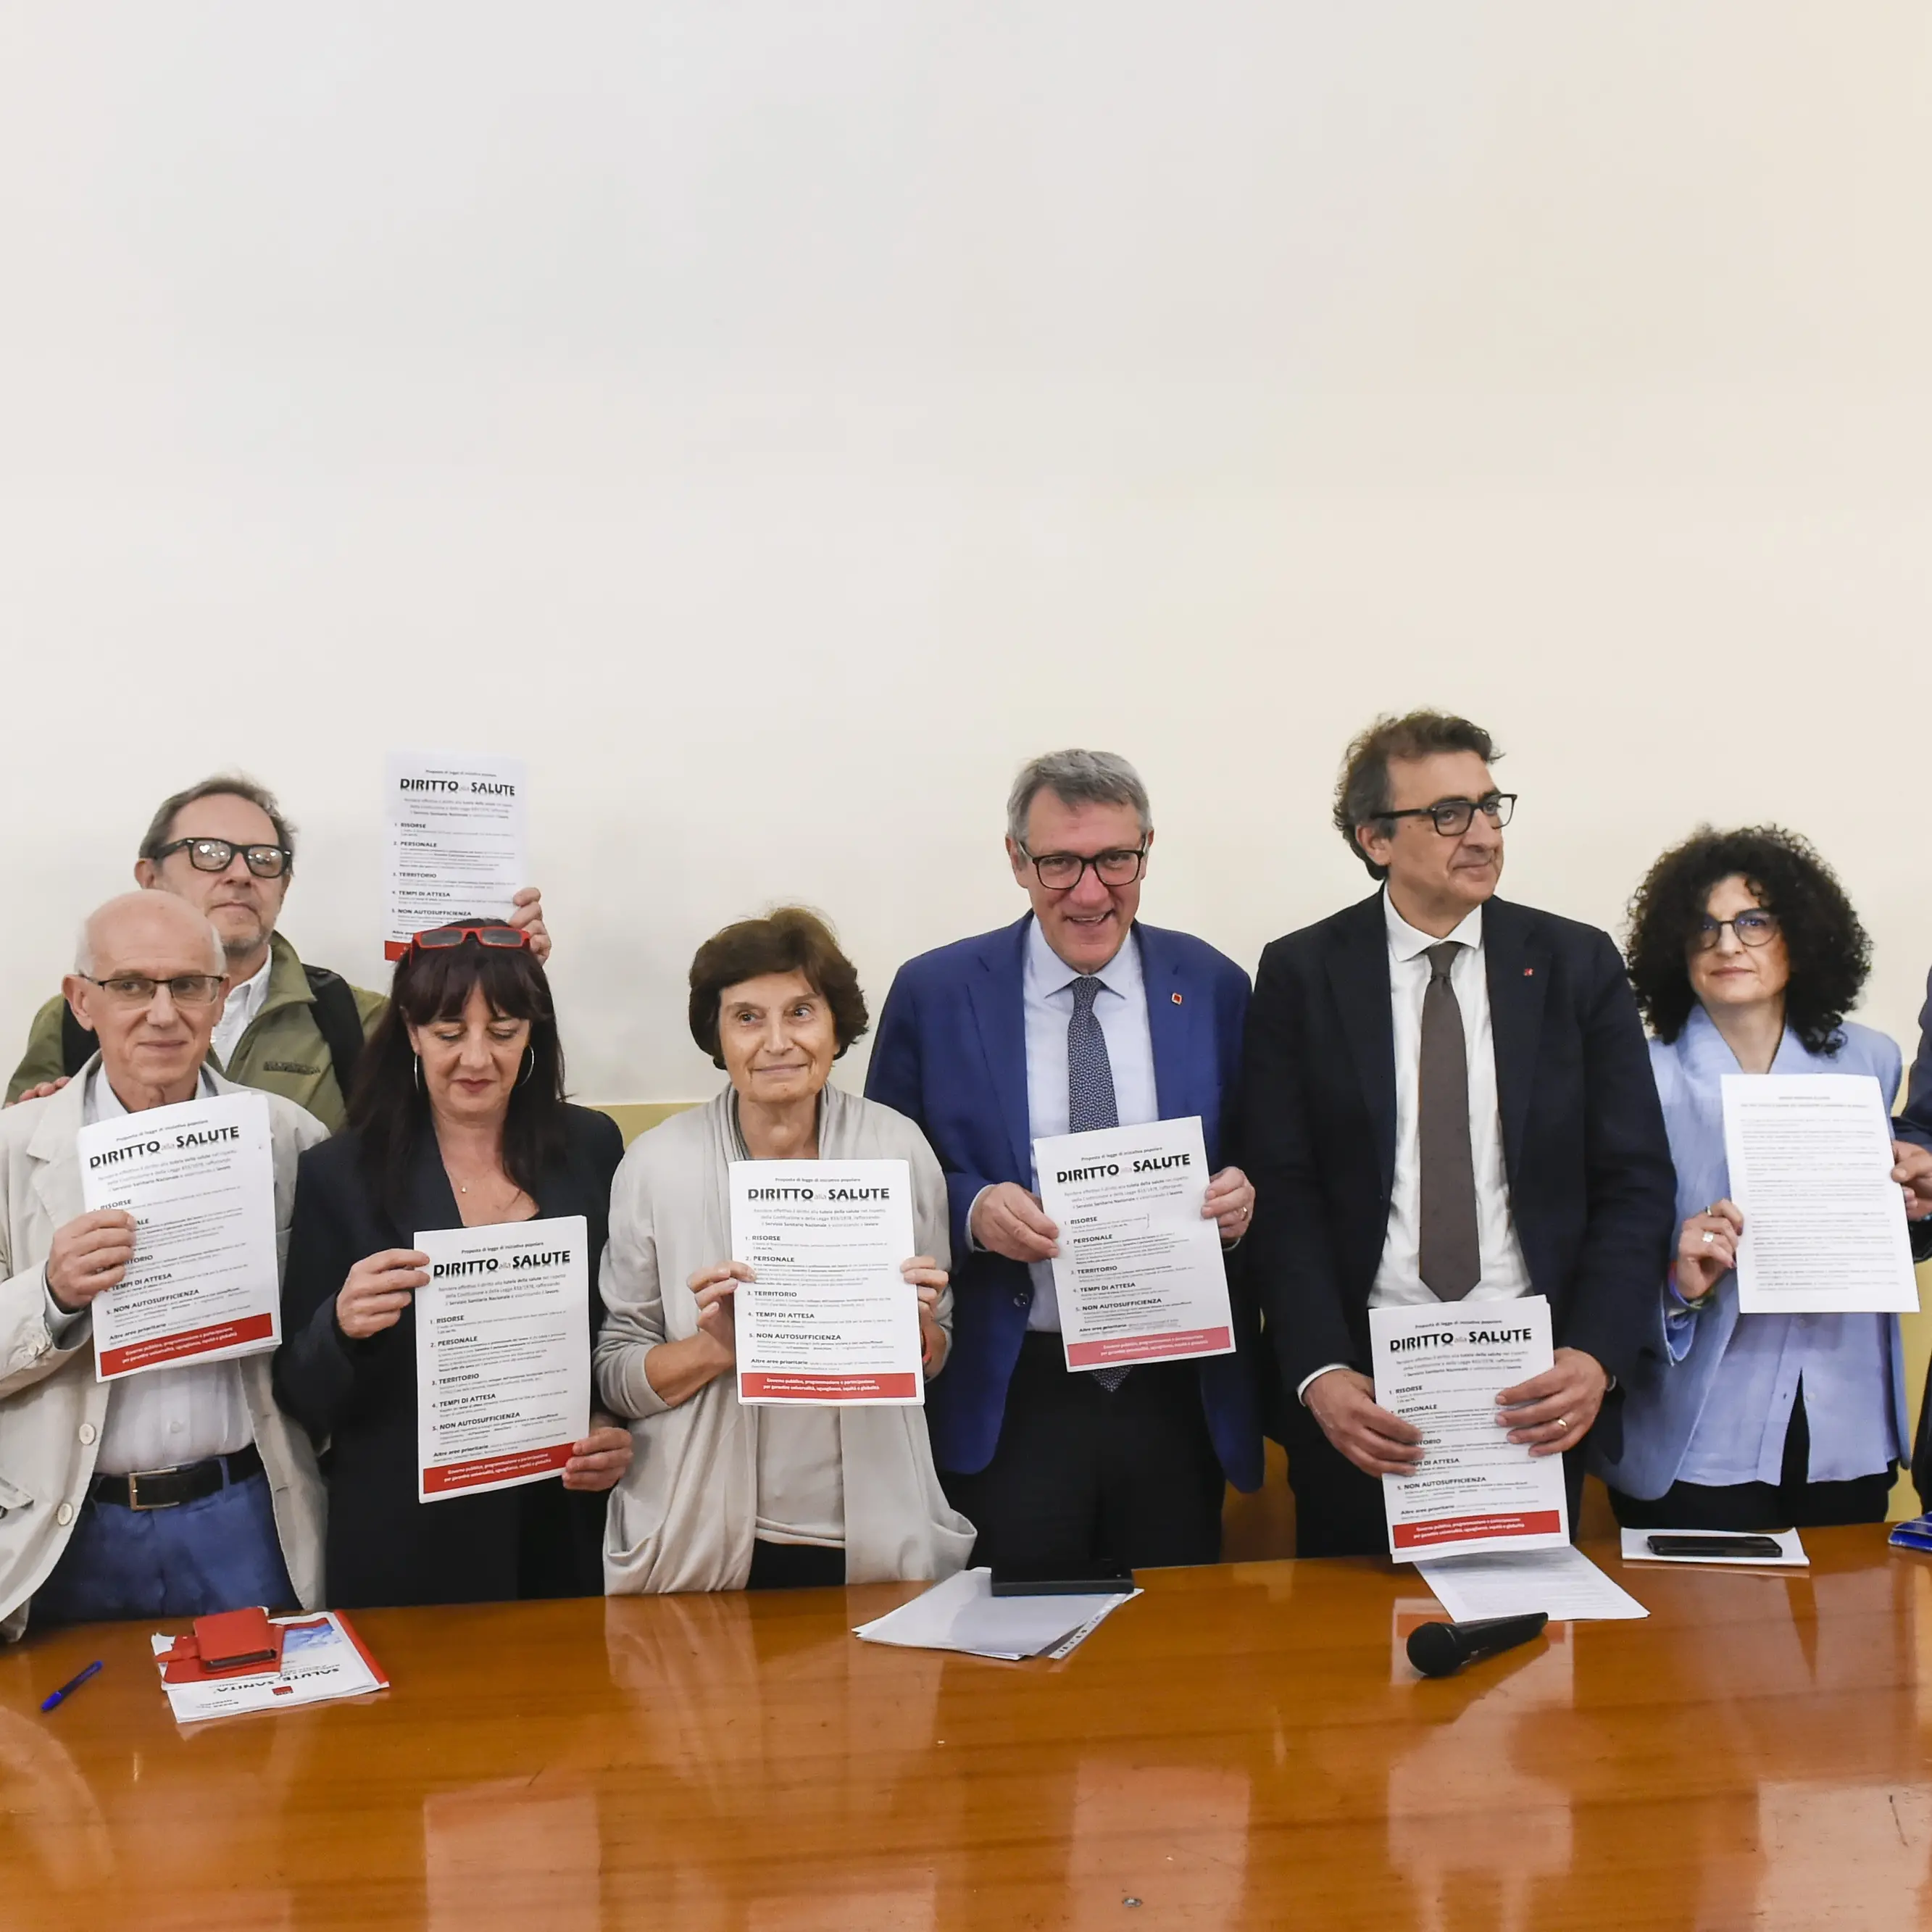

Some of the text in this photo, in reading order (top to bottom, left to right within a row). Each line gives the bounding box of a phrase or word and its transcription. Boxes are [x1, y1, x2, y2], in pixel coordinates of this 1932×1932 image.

[400, 778, 515, 796] DIRITTO SALUTE
[90, 1141, 161, 1169] DIRITTO
[176, 1126, 240, 1148] SALUTE
[1057, 1164, 1120, 1183] DIRITTO
[1133, 1154, 1191, 1172] SALUTE
[748, 1188, 814, 1199] DIRITTO
[828, 1188, 890, 1199] SALUTE
[100, 1199, 131, 1209] RISORSE
[1073, 1234, 1113, 1244] PERSONALE
[433, 1258, 499, 1277] DIRITTO
[512, 1250, 570, 1267] SALUTE
[1078, 1265, 1117, 1274] TERRITORIO
[112, 1281, 133, 1291] TEMPI
[143, 1273, 172, 1283] ATTESA
[114, 1304, 130, 1313] NON
[132, 1288, 199, 1308] AUTOSUFFICIENZA
[1099, 1298, 1162, 1309] AUTOSUFFICIENZA
[438, 1336, 478, 1346] PERSONALE
[1390, 1333, 1454, 1352] DIRITTO
[1469, 1328, 1532, 1343] SALUTE
[438, 1373, 479, 1385] TERRITORIO
[1396, 1386, 1423, 1394] RISORSE
[439, 1399, 460, 1407] TEMPI
[470, 1394, 496, 1402] ATTESA
[1398, 1404, 1437, 1414] PERSONALE
[458, 1412, 520, 1427] AUTOSUFFICIENZA
[461, 1444, 488, 1454] prioritarie
[1422, 1476, 1486, 1487] AUTOSUFFICIENZA
[283, 1667, 340, 1682] SALUTE
